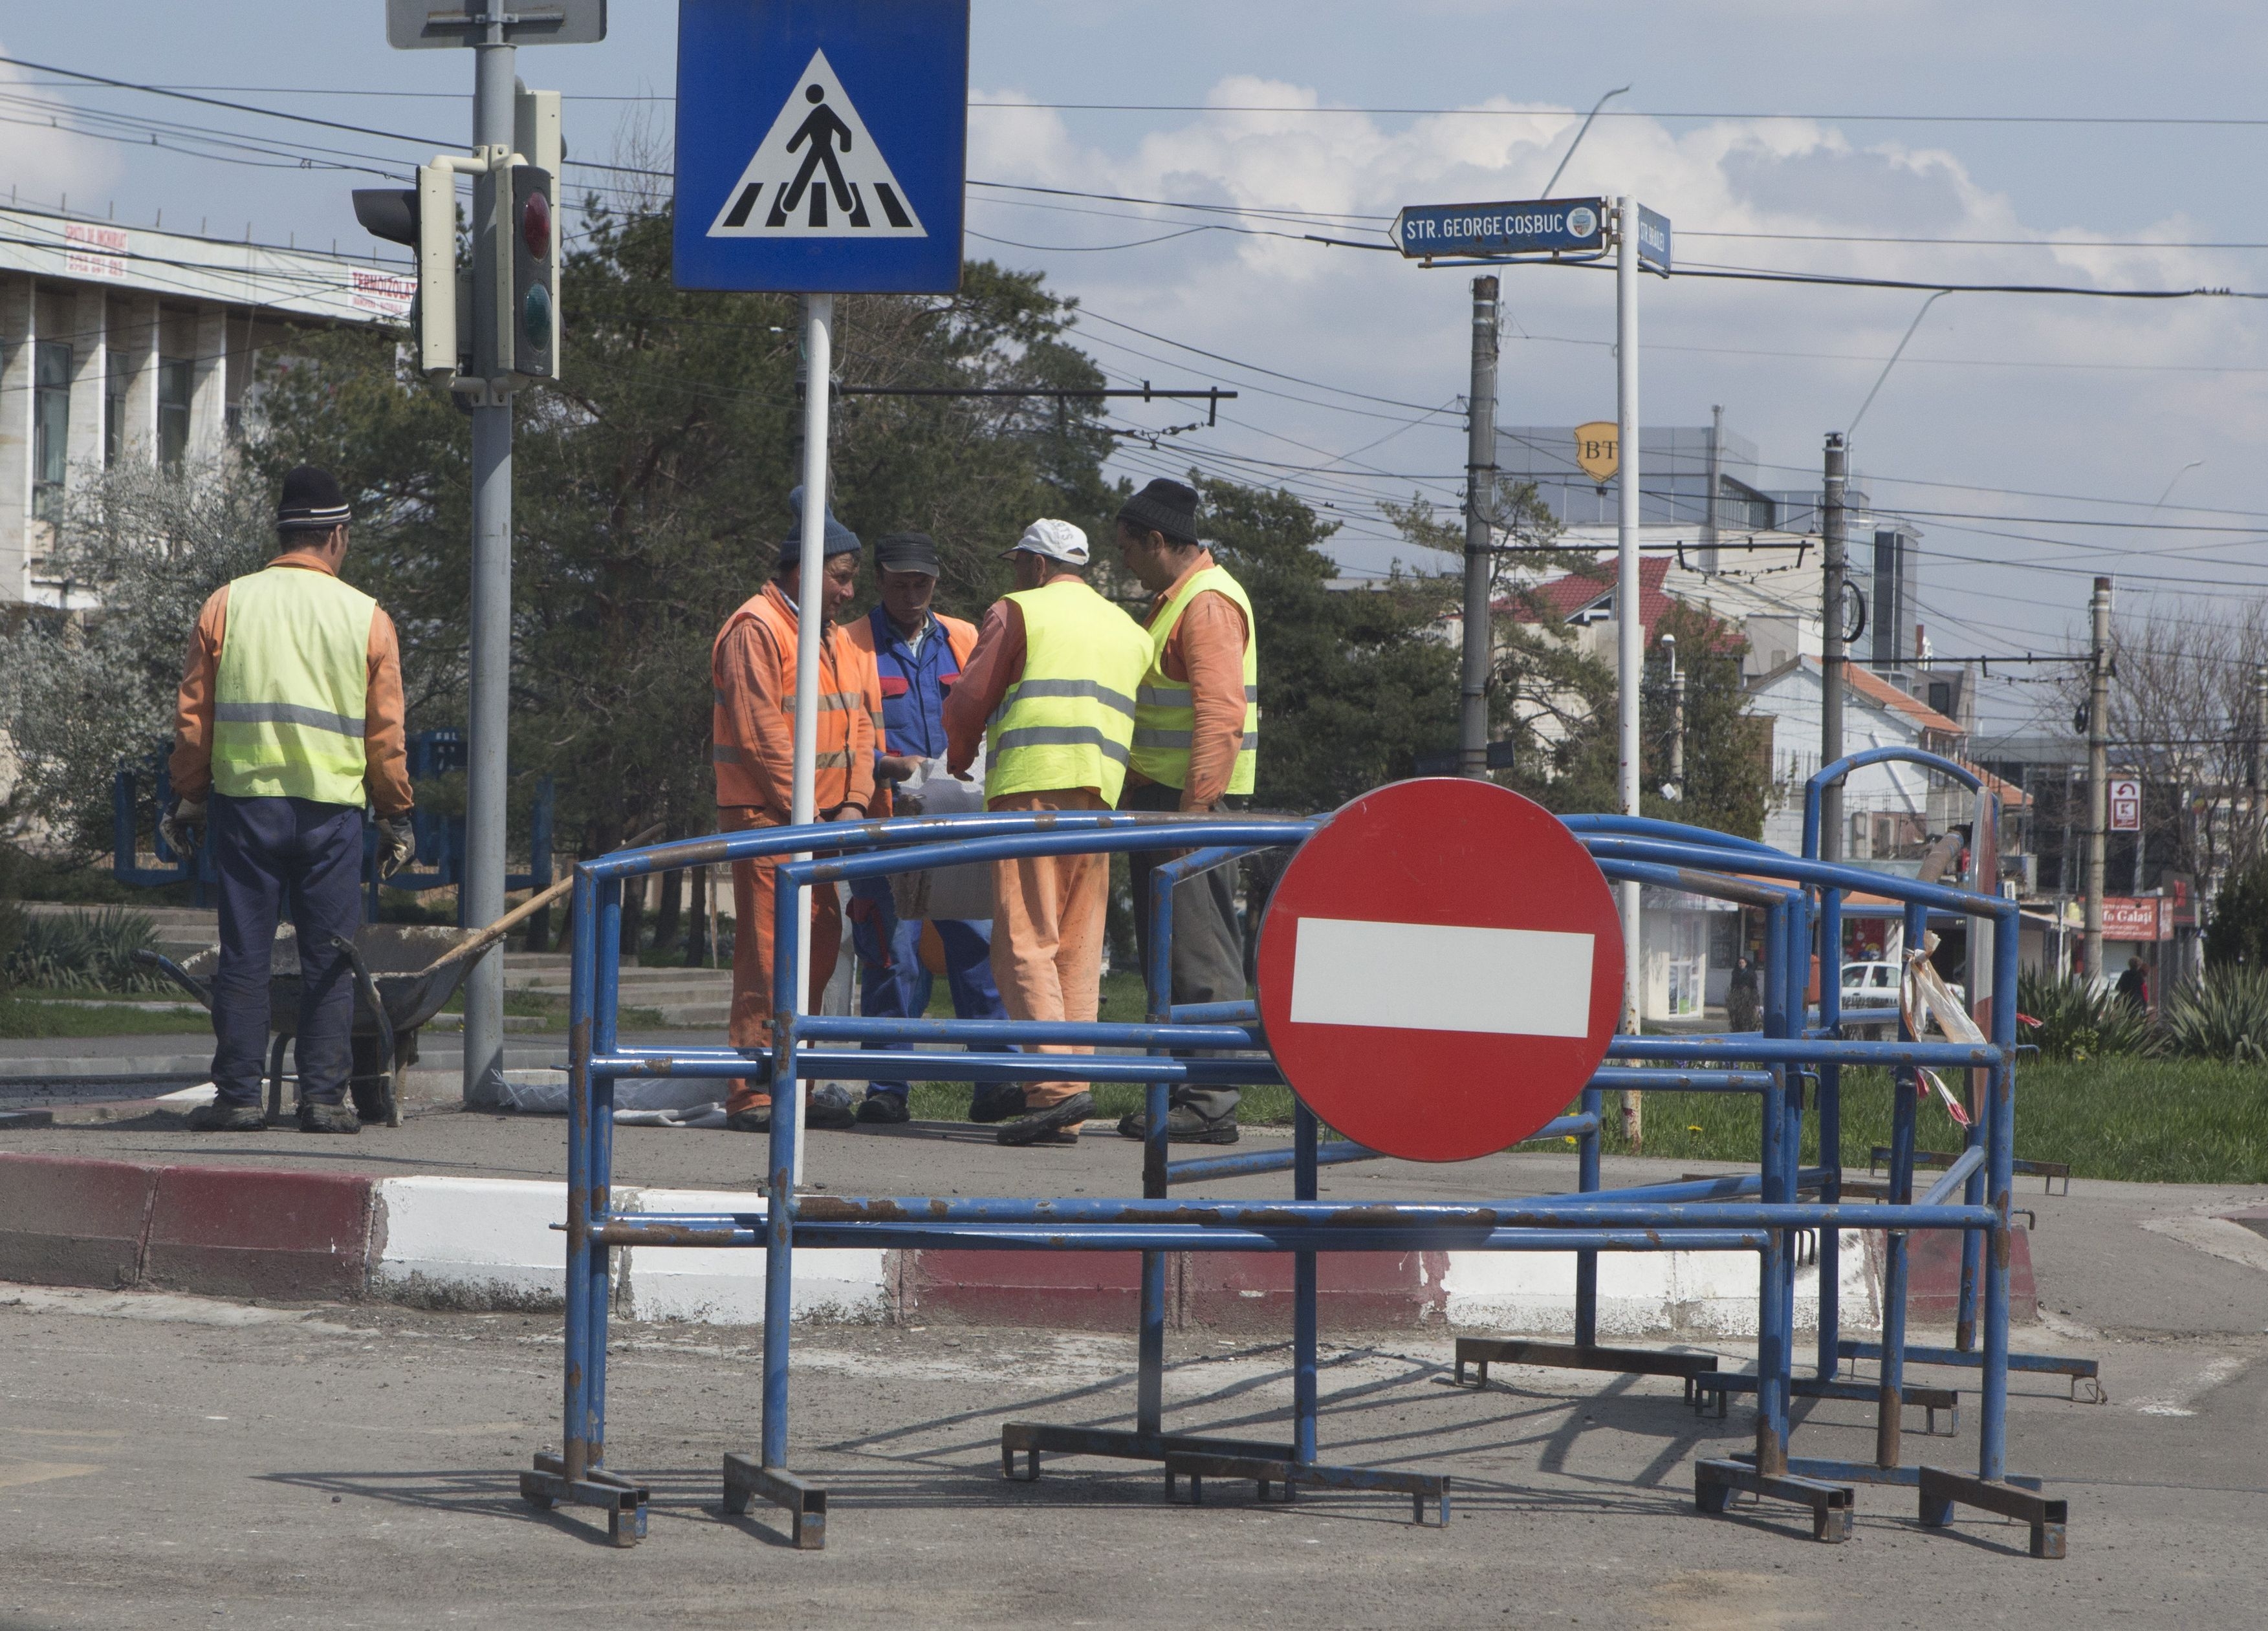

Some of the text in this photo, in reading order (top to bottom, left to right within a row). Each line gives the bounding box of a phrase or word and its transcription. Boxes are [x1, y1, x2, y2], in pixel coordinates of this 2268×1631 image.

[1406, 221, 1441, 239] STR.
[1443, 217, 1502, 237] GEORGE
[1586, 440, 1618, 459] BT
